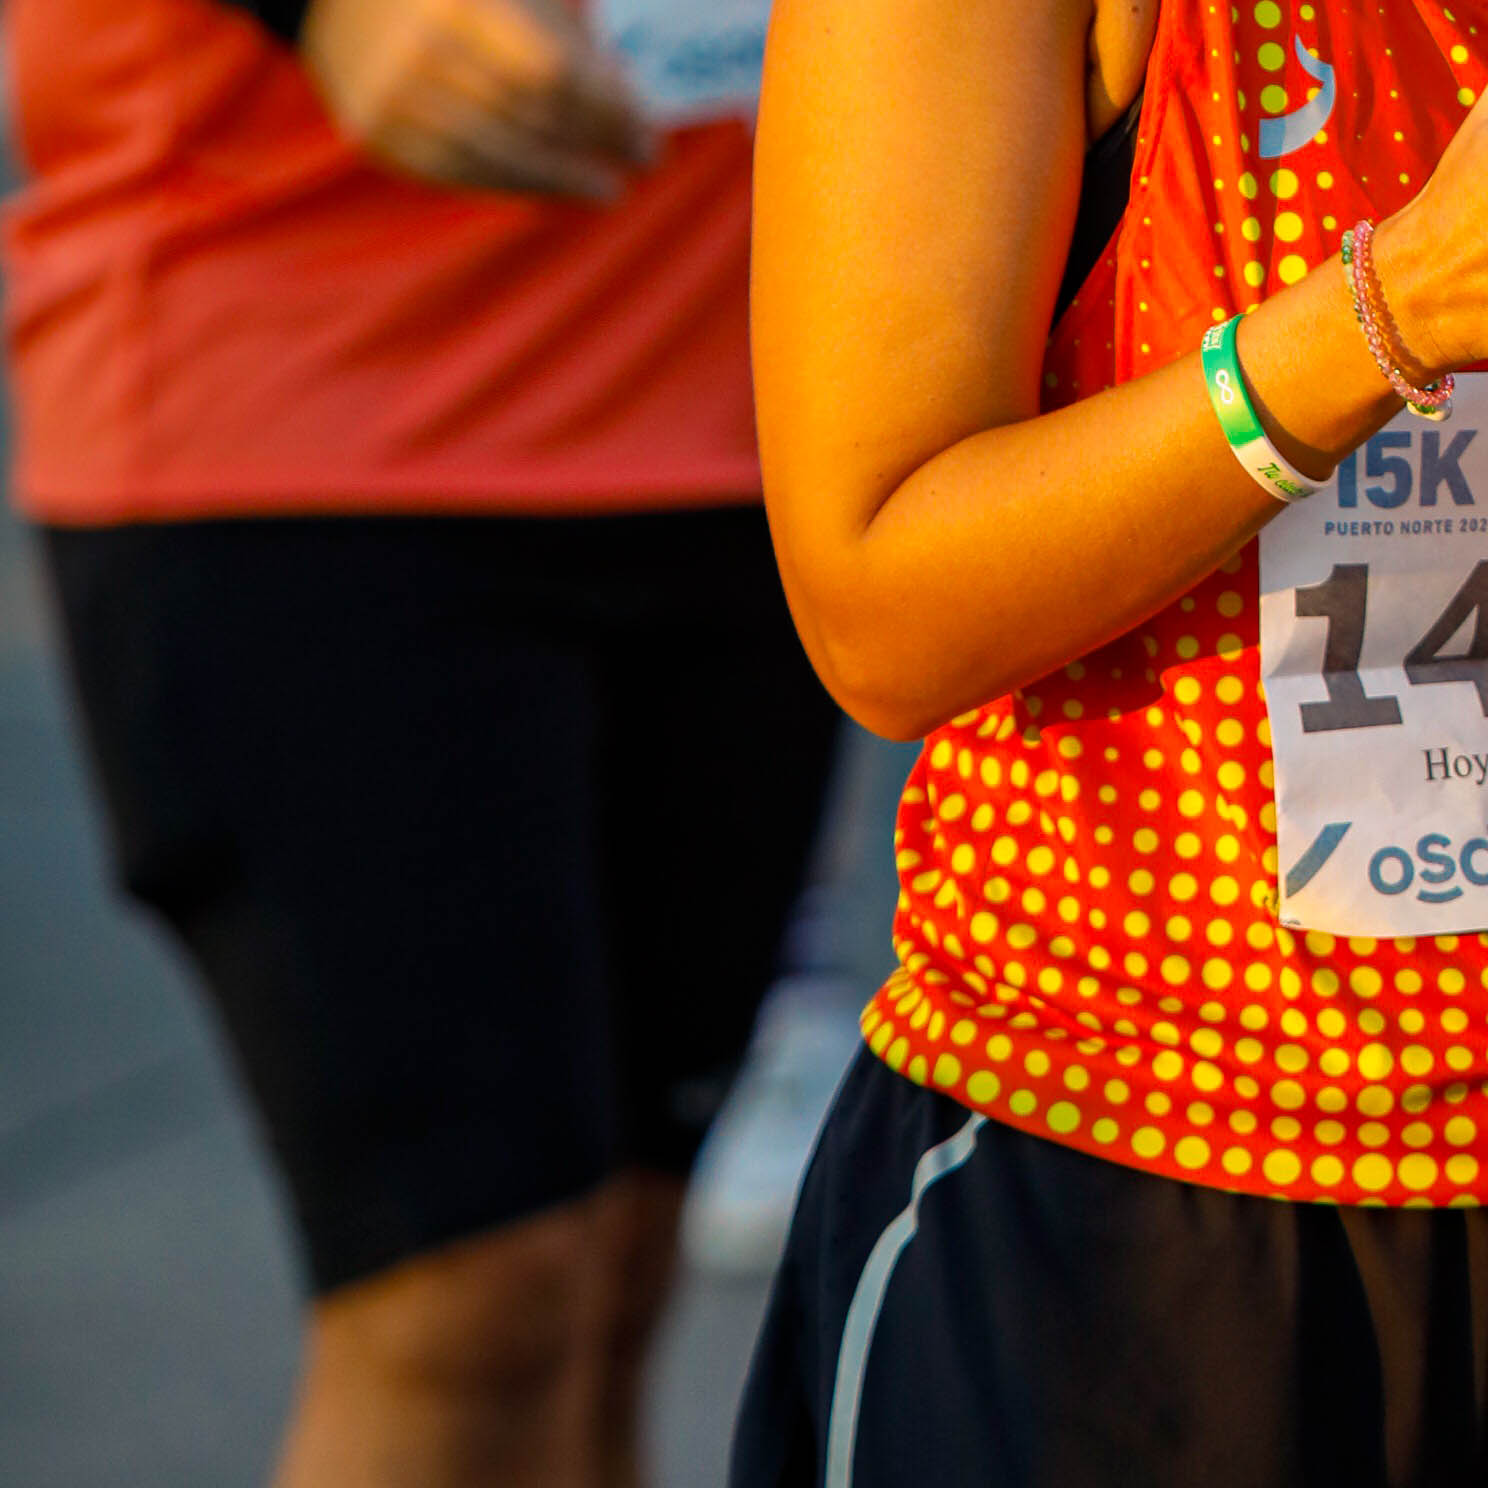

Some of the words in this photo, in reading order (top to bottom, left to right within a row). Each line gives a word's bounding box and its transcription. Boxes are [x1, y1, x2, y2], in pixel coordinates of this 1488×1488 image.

[1336, 428, 1477, 509] 15K
[1324, 519, 1395, 537] PUERTO
[1400, 517, 1454, 534] NORTE
